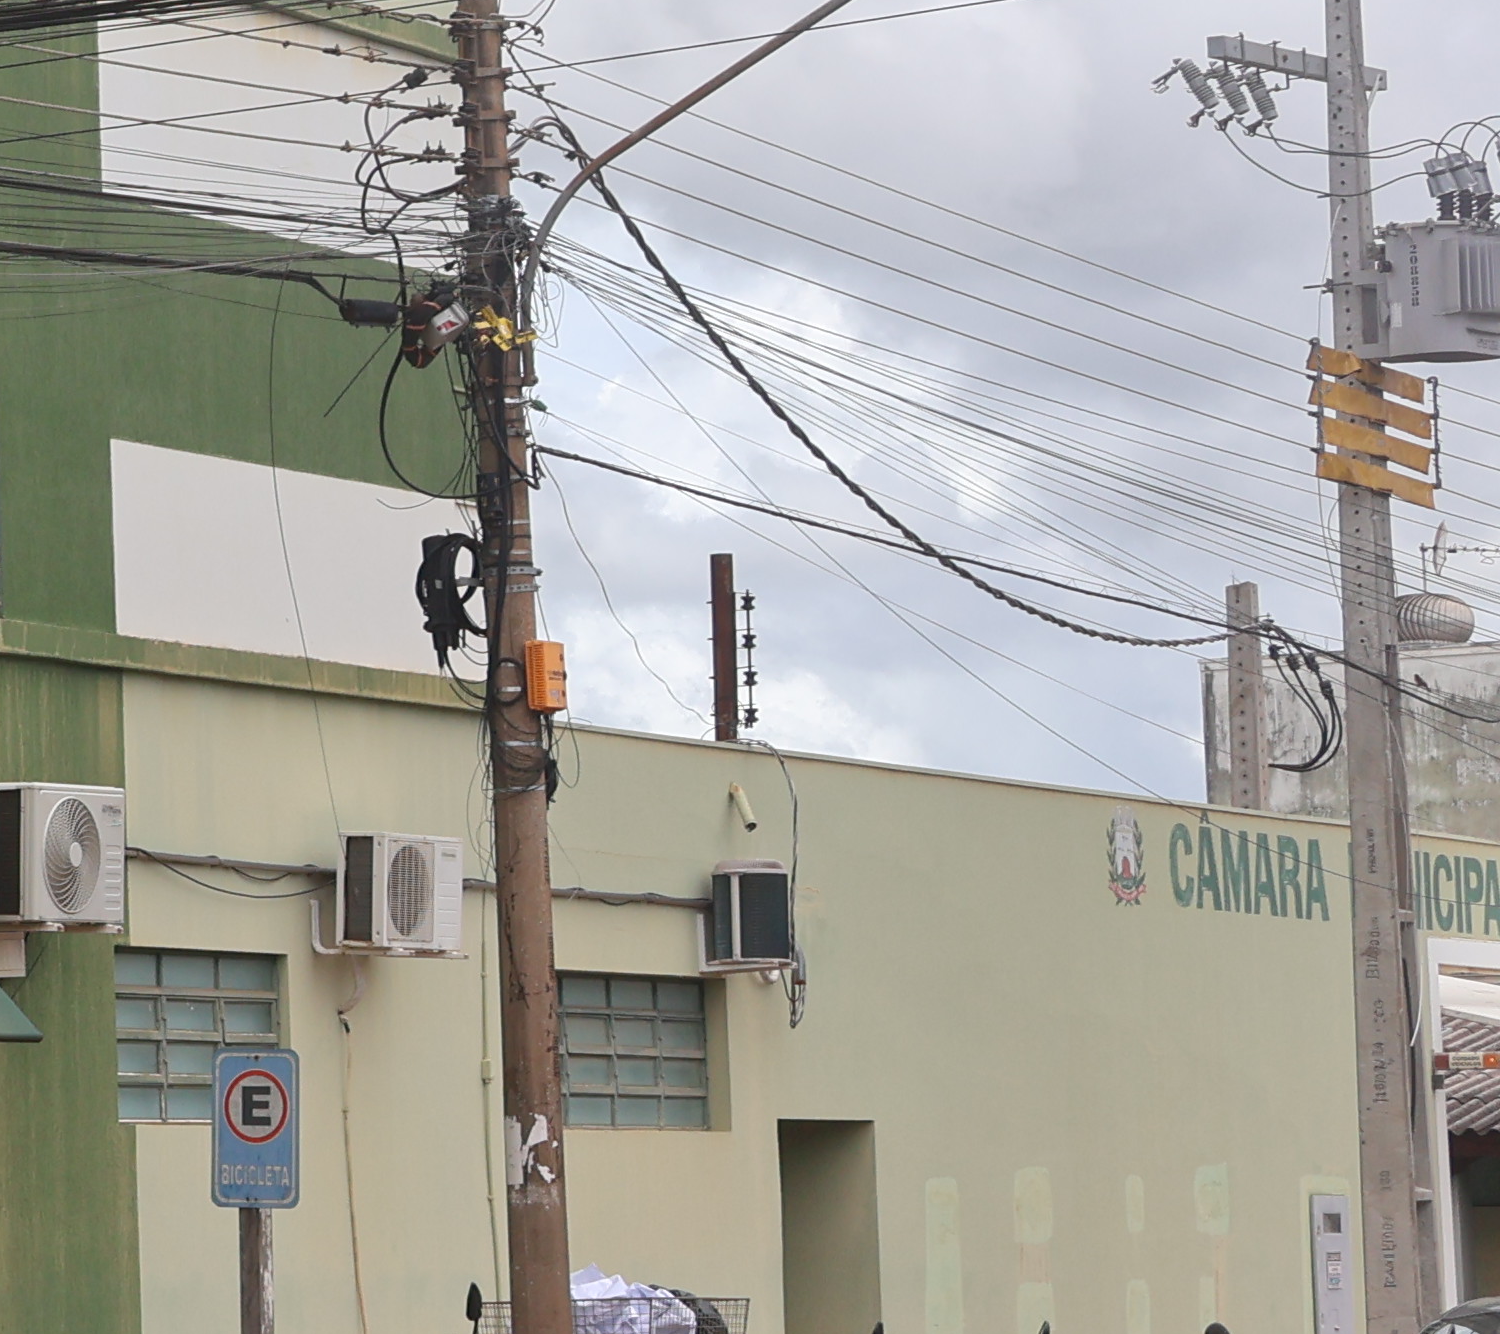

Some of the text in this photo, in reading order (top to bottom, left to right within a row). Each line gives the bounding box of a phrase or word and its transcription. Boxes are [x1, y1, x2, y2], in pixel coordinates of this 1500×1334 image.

[1168, 811, 1330, 922] CÂMARA
[241, 1085, 271, 1126] E
[221, 1164, 290, 1187] BICICLETA
